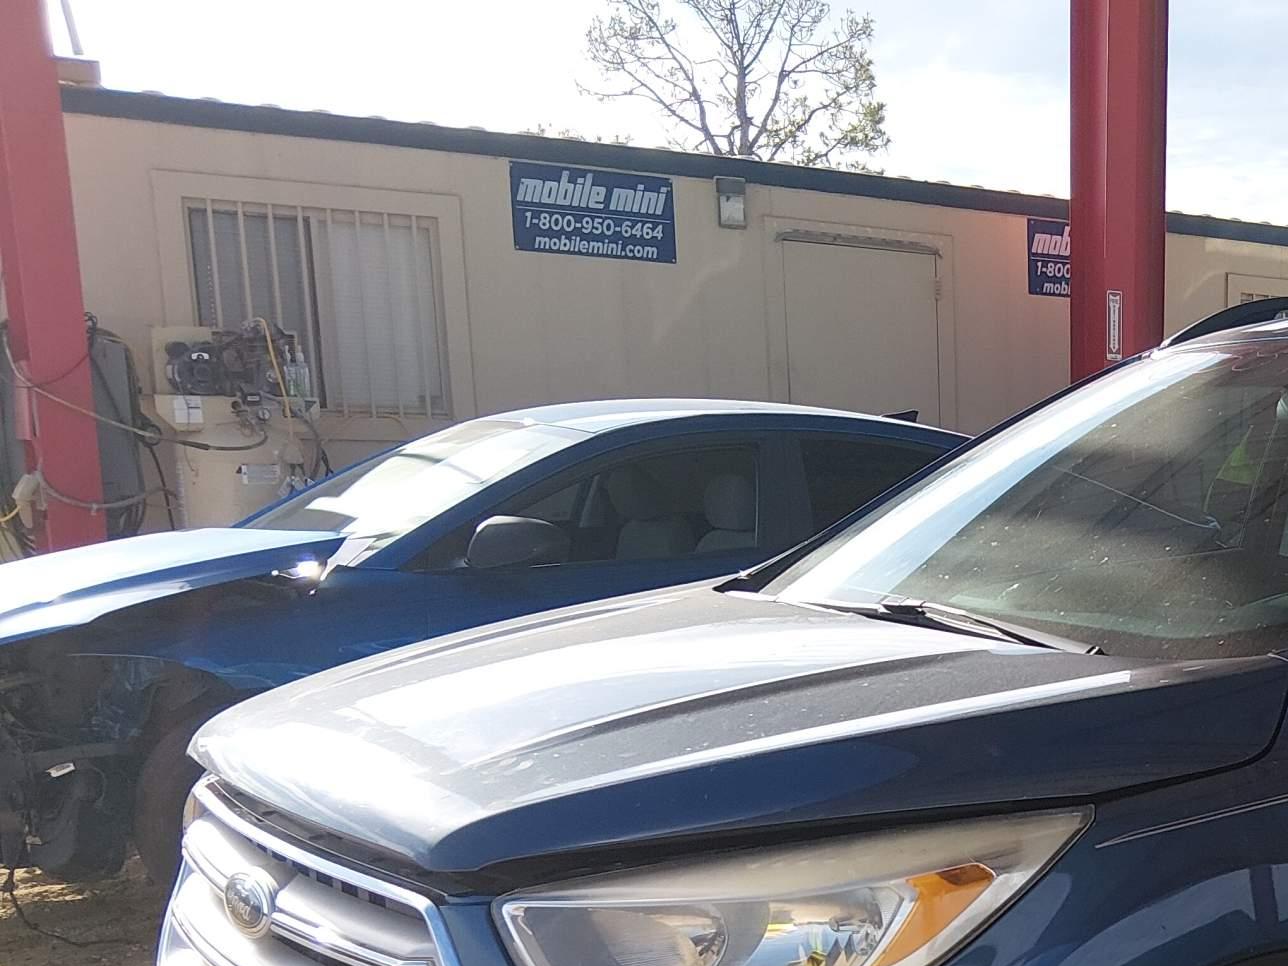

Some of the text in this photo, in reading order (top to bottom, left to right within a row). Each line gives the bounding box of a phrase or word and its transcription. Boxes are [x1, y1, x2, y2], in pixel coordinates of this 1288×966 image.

[516, 170, 668, 215] mobile mini
[524, 211, 664, 240] 1-800-950-6464
[534, 235, 658, 259] mobilemini.com
[1031, 226, 1071, 256] mob
[1036, 262, 1071, 279] 1-800
